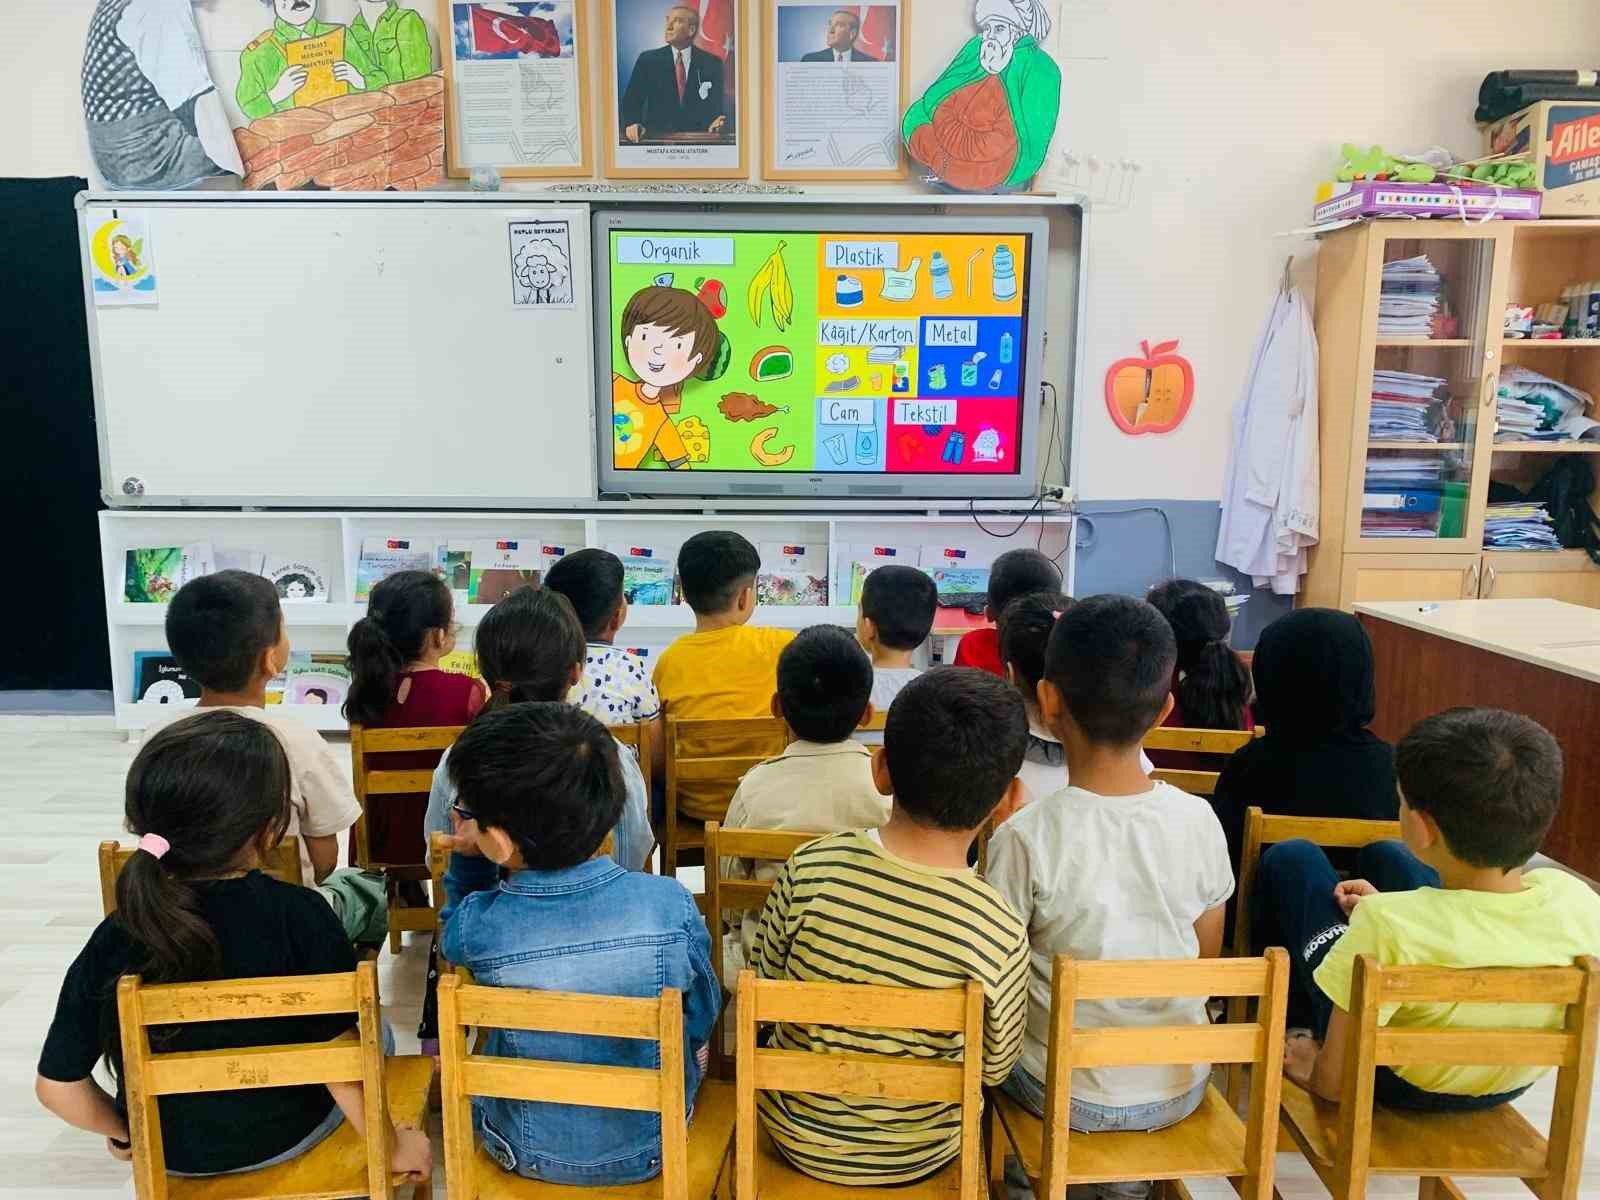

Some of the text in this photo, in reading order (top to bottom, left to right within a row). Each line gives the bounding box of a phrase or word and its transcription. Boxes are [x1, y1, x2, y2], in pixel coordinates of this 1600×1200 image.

[1554, 119, 1600, 158] Aile
[641, 239, 701, 263] Organik
[834, 244, 885, 267] Plastik
[932, 322, 972, 343] Metal
[829, 401, 860, 421] Cam
[900, 402, 948, 425] Tekstil
